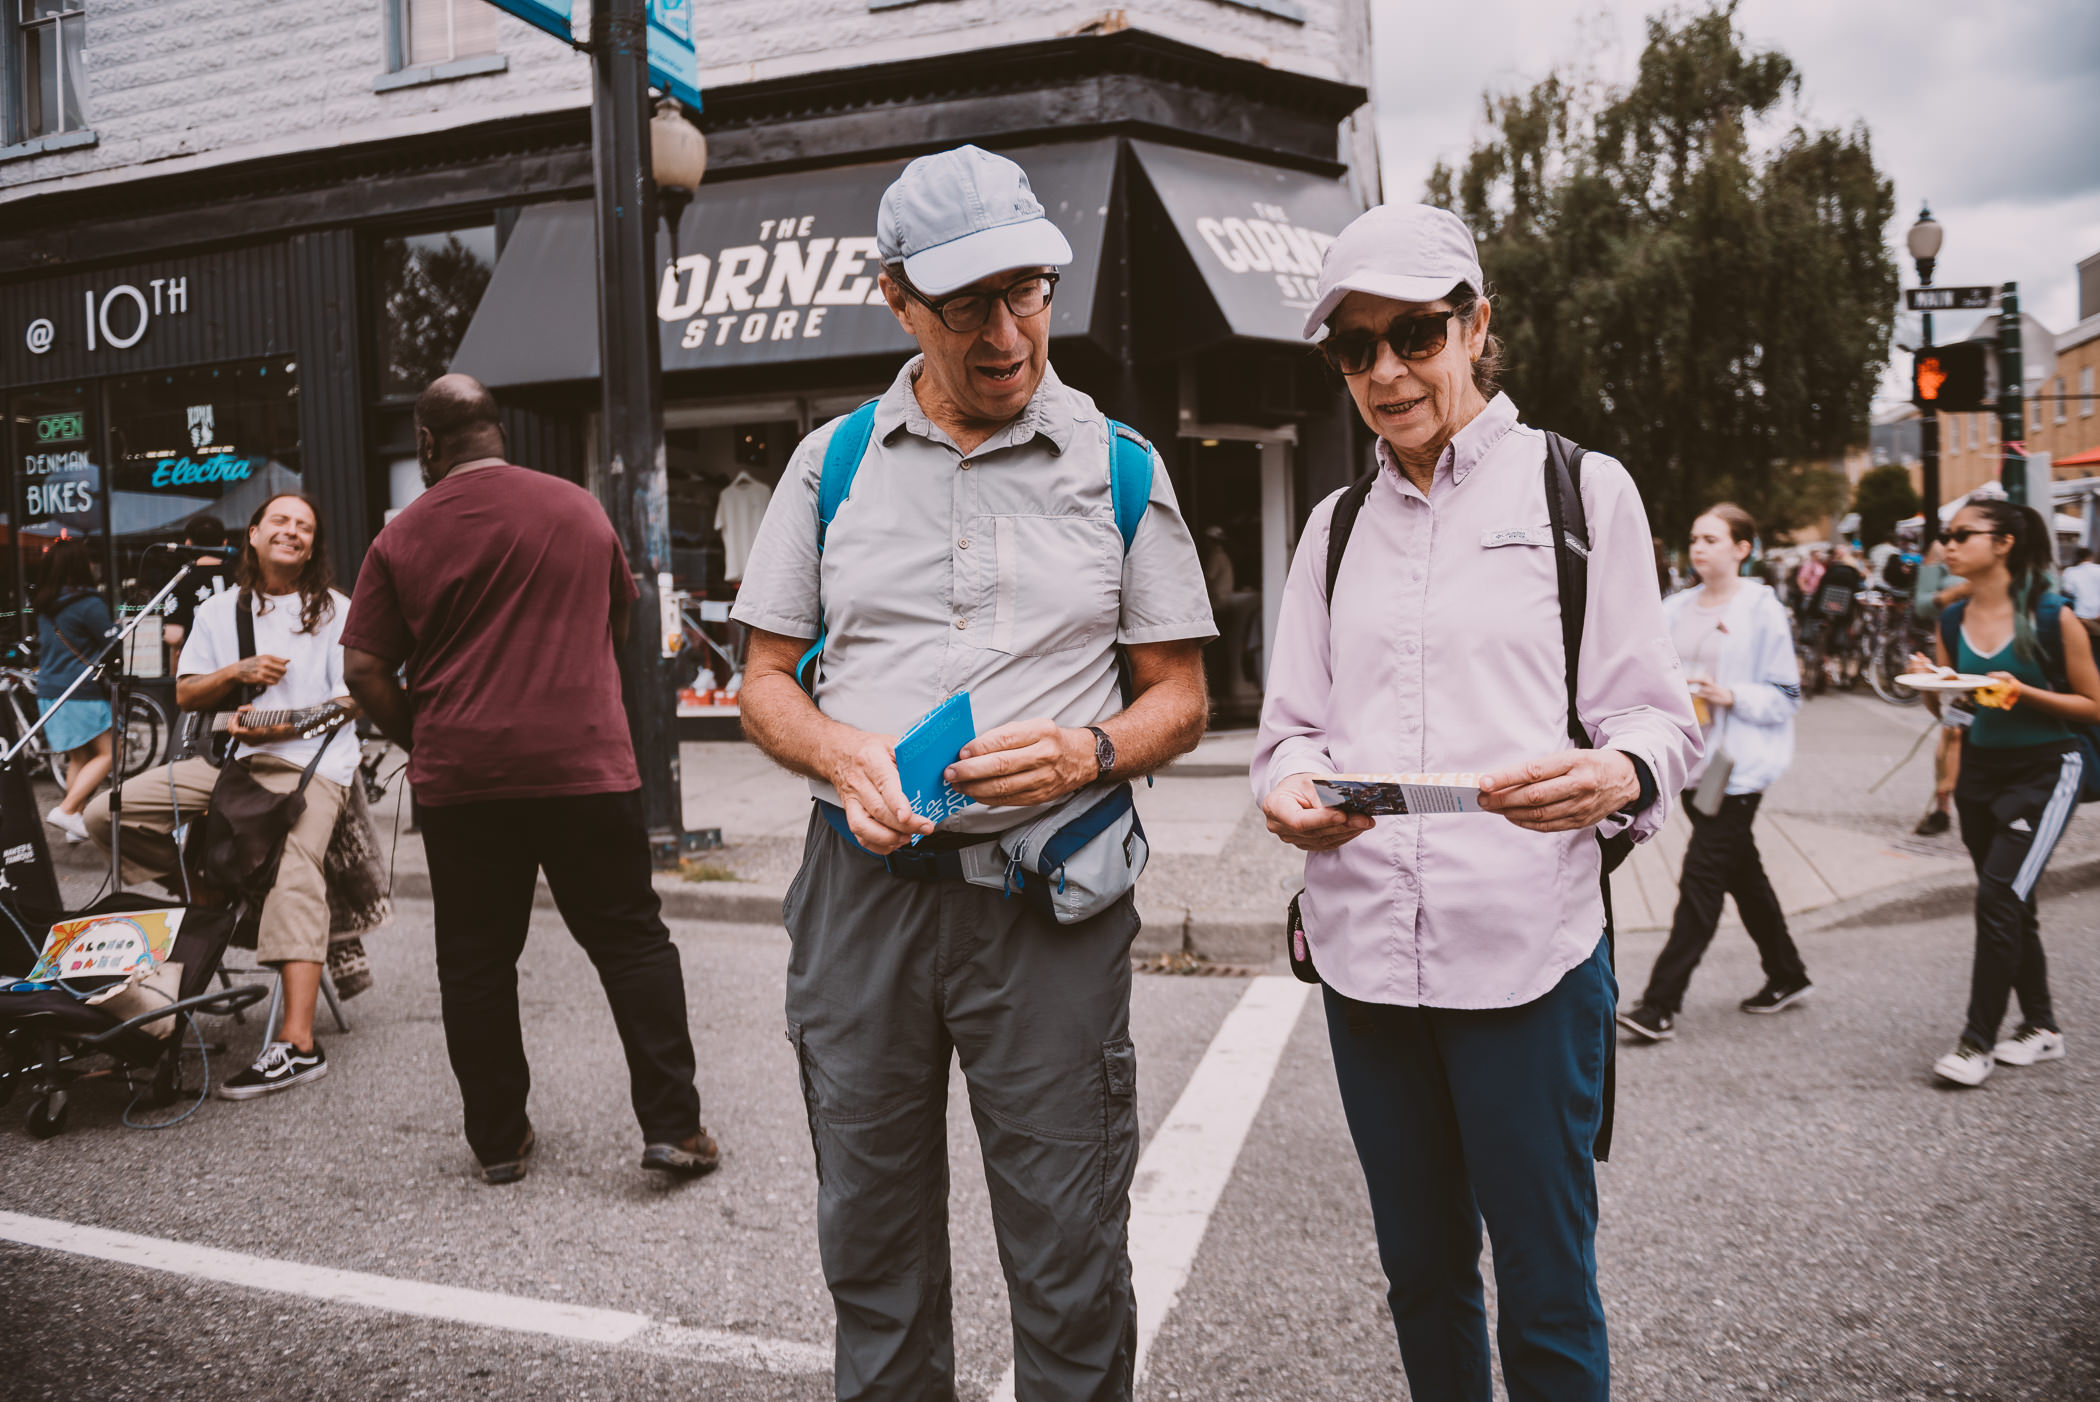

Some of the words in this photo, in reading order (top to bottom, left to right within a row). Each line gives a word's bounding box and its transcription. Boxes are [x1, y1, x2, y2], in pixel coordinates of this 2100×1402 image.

[759, 215, 816, 242] THE
[1196, 216, 1337, 274] CORN
[657, 236, 889, 323] ORNE
[26, 318, 55, 354] @
[681, 307, 828, 349] STORE
[37, 416, 83, 440] OPEN
[25, 451, 90, 476] DENMAN
[151, 453, 252, 488] Electra
[26, 480, 93, 516] BIKES
